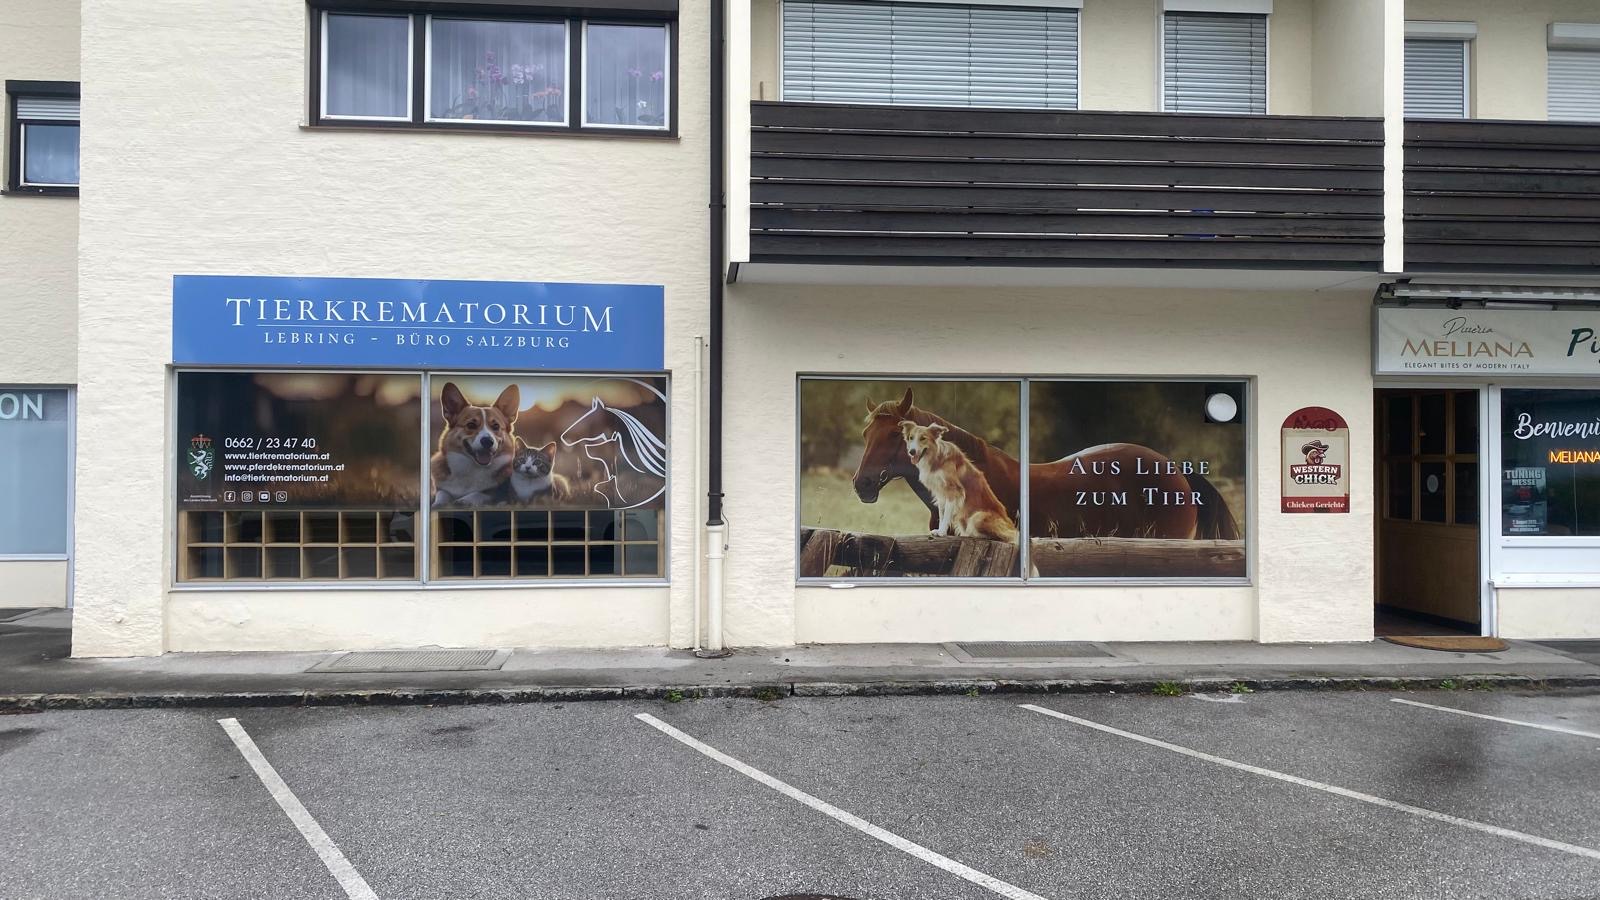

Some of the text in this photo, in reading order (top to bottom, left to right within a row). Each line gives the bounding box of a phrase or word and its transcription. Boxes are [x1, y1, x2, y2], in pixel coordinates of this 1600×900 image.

[225, 297, 614, 334] TIERKREMATORIUM
[264, 332, 356, 346] LEBRING
[396, 330, 452, 347] BÜRO
[466, 335, 571, 349] SALZBURG
[1567, 328, 1600, 357] Pi
[1401, 338, 1534, 358] MELIANA
[1514, 413, 1600, 440] Benvenu
[224, 437, 316, 451] 0662 / 23 47 40
[224, 452, 330, 460] www.tierkrematorium.at
[224, 463, 345, 472] www.pferdekrematorium.at
[1293, 465, 1338, 474] WESTERN
[224, 474, 329, 482] info@tierkrematorium.at
[1295, 473, 1337, 485] CHICK
[1286, 501, 1345, 509] Chicken Gerichte
